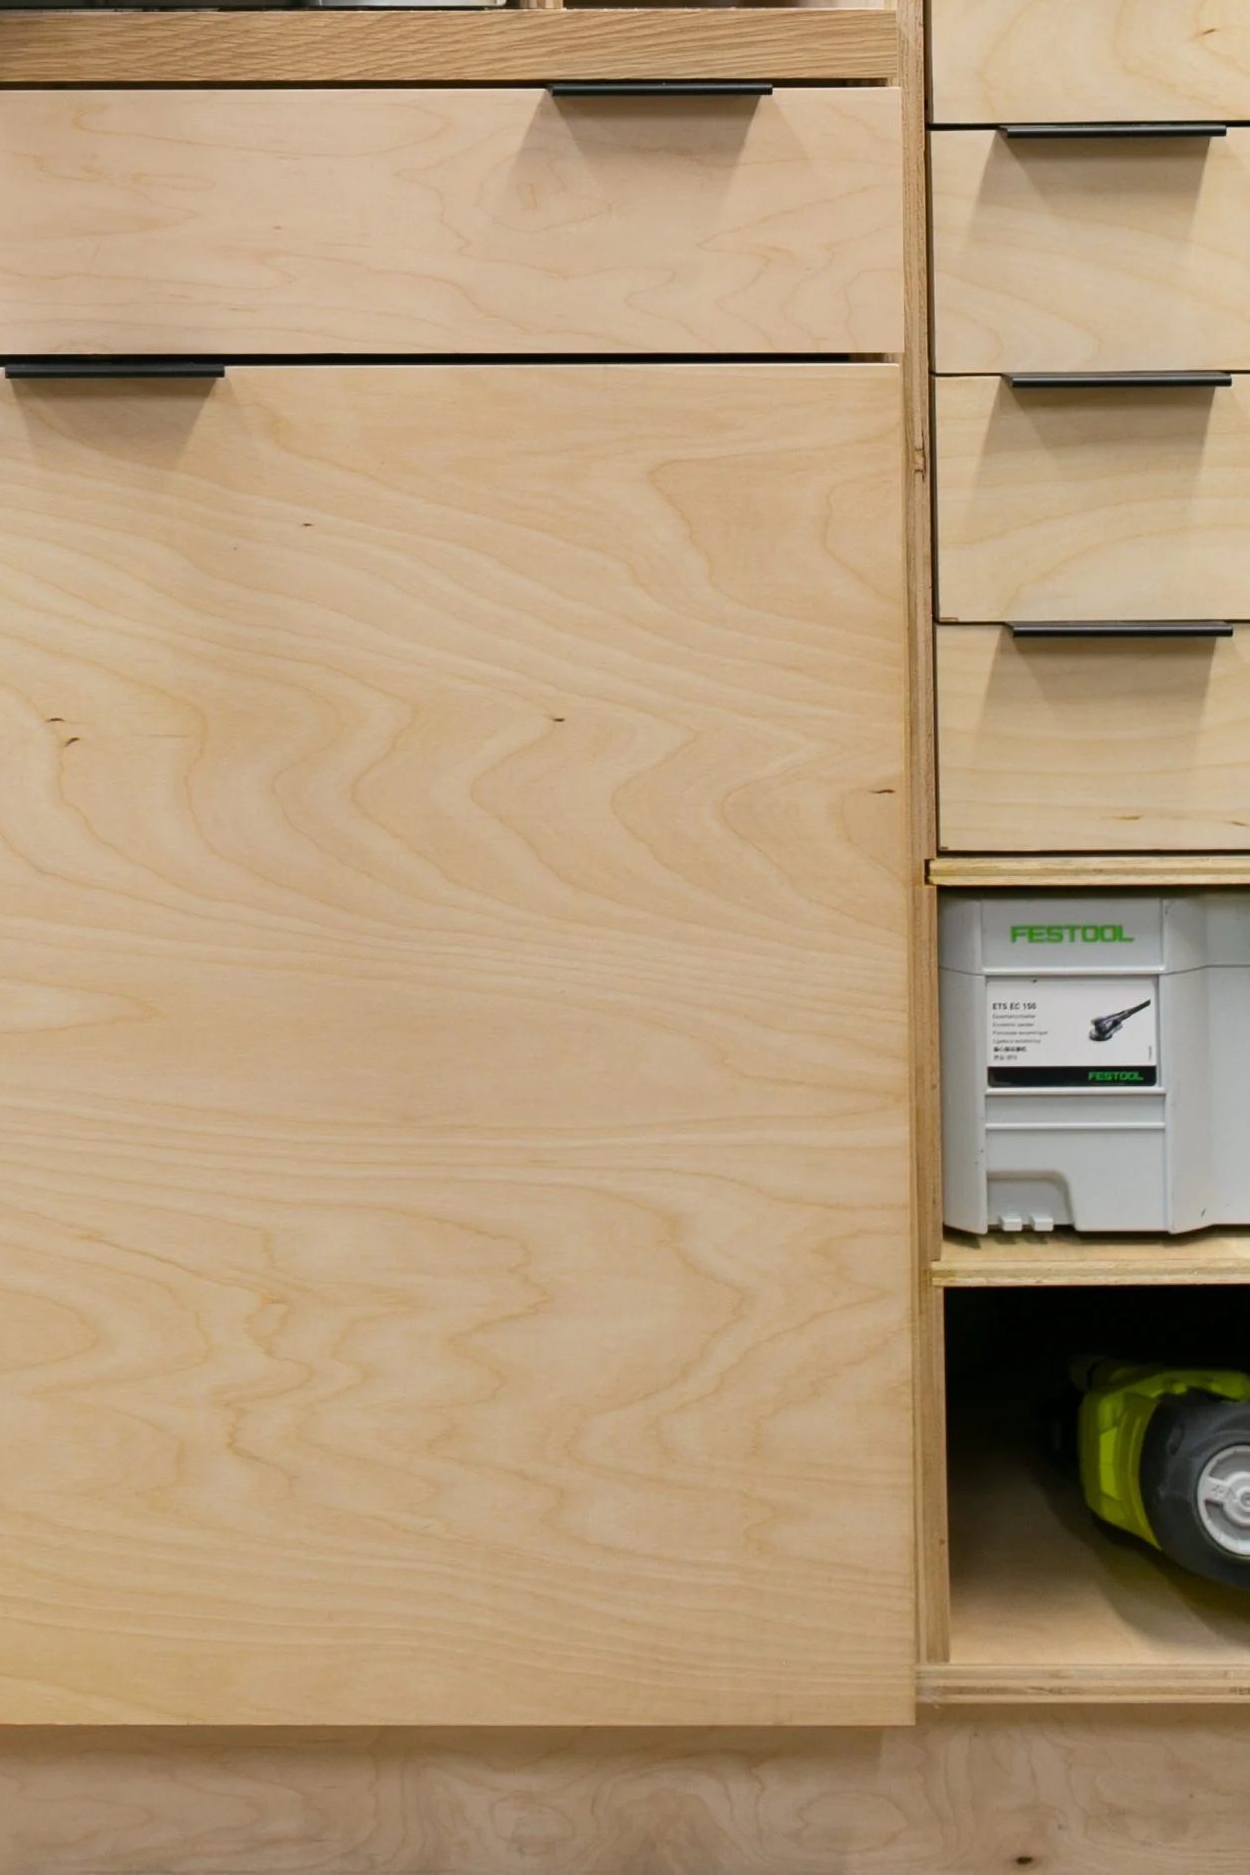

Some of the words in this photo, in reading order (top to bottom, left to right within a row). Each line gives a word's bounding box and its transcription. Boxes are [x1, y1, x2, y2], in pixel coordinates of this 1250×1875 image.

[1010, 924, 1135, 944] FESTOOL
[992, 1002, 1008, 1011] ETS
[1009, 1002, 1021, 1011] EC
[1022, 1002, 1037, 1011] 150
[1087, 1071, 1144, 1081] FESTOOL
